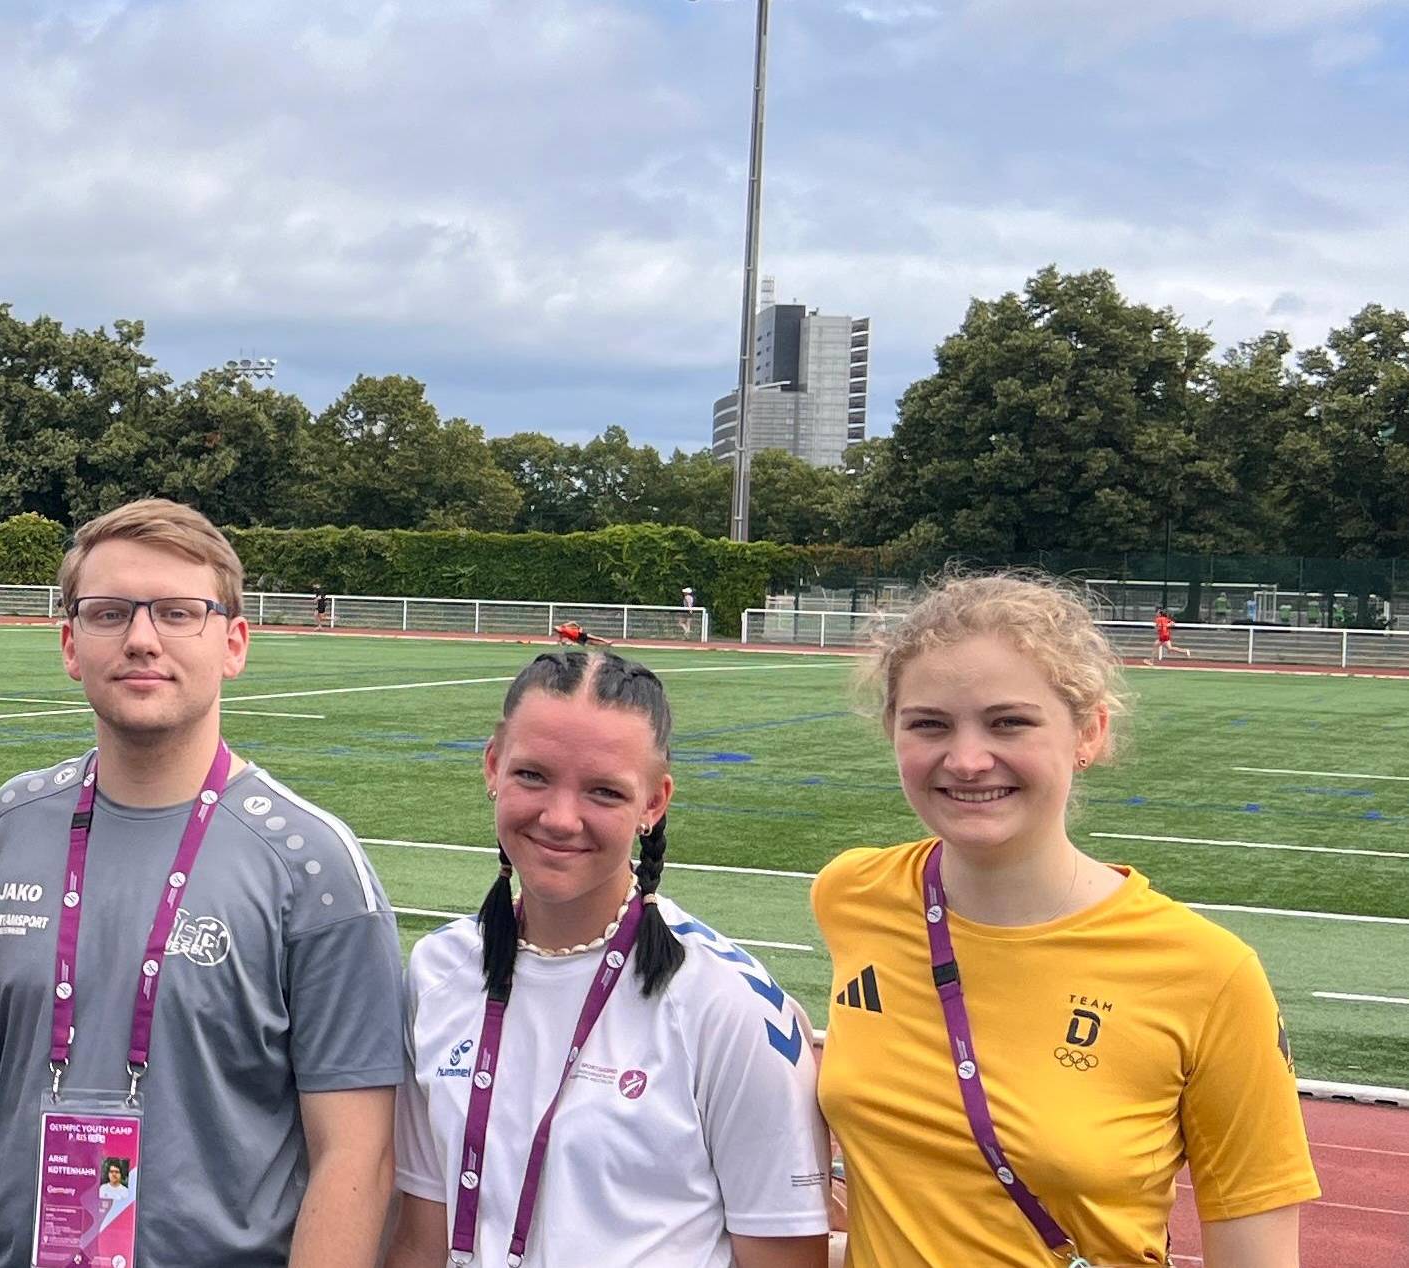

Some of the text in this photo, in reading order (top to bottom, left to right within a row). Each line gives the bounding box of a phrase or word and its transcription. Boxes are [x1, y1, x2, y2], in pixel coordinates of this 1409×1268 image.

[0, 883, 43, 902] JAKO
[1069, 994, 1113, 1012] TEAM
[49, 1123, 133, 1135] OLYMPIC YOUTH CAMP
[68, 1133, 87, 1142] PRIS
